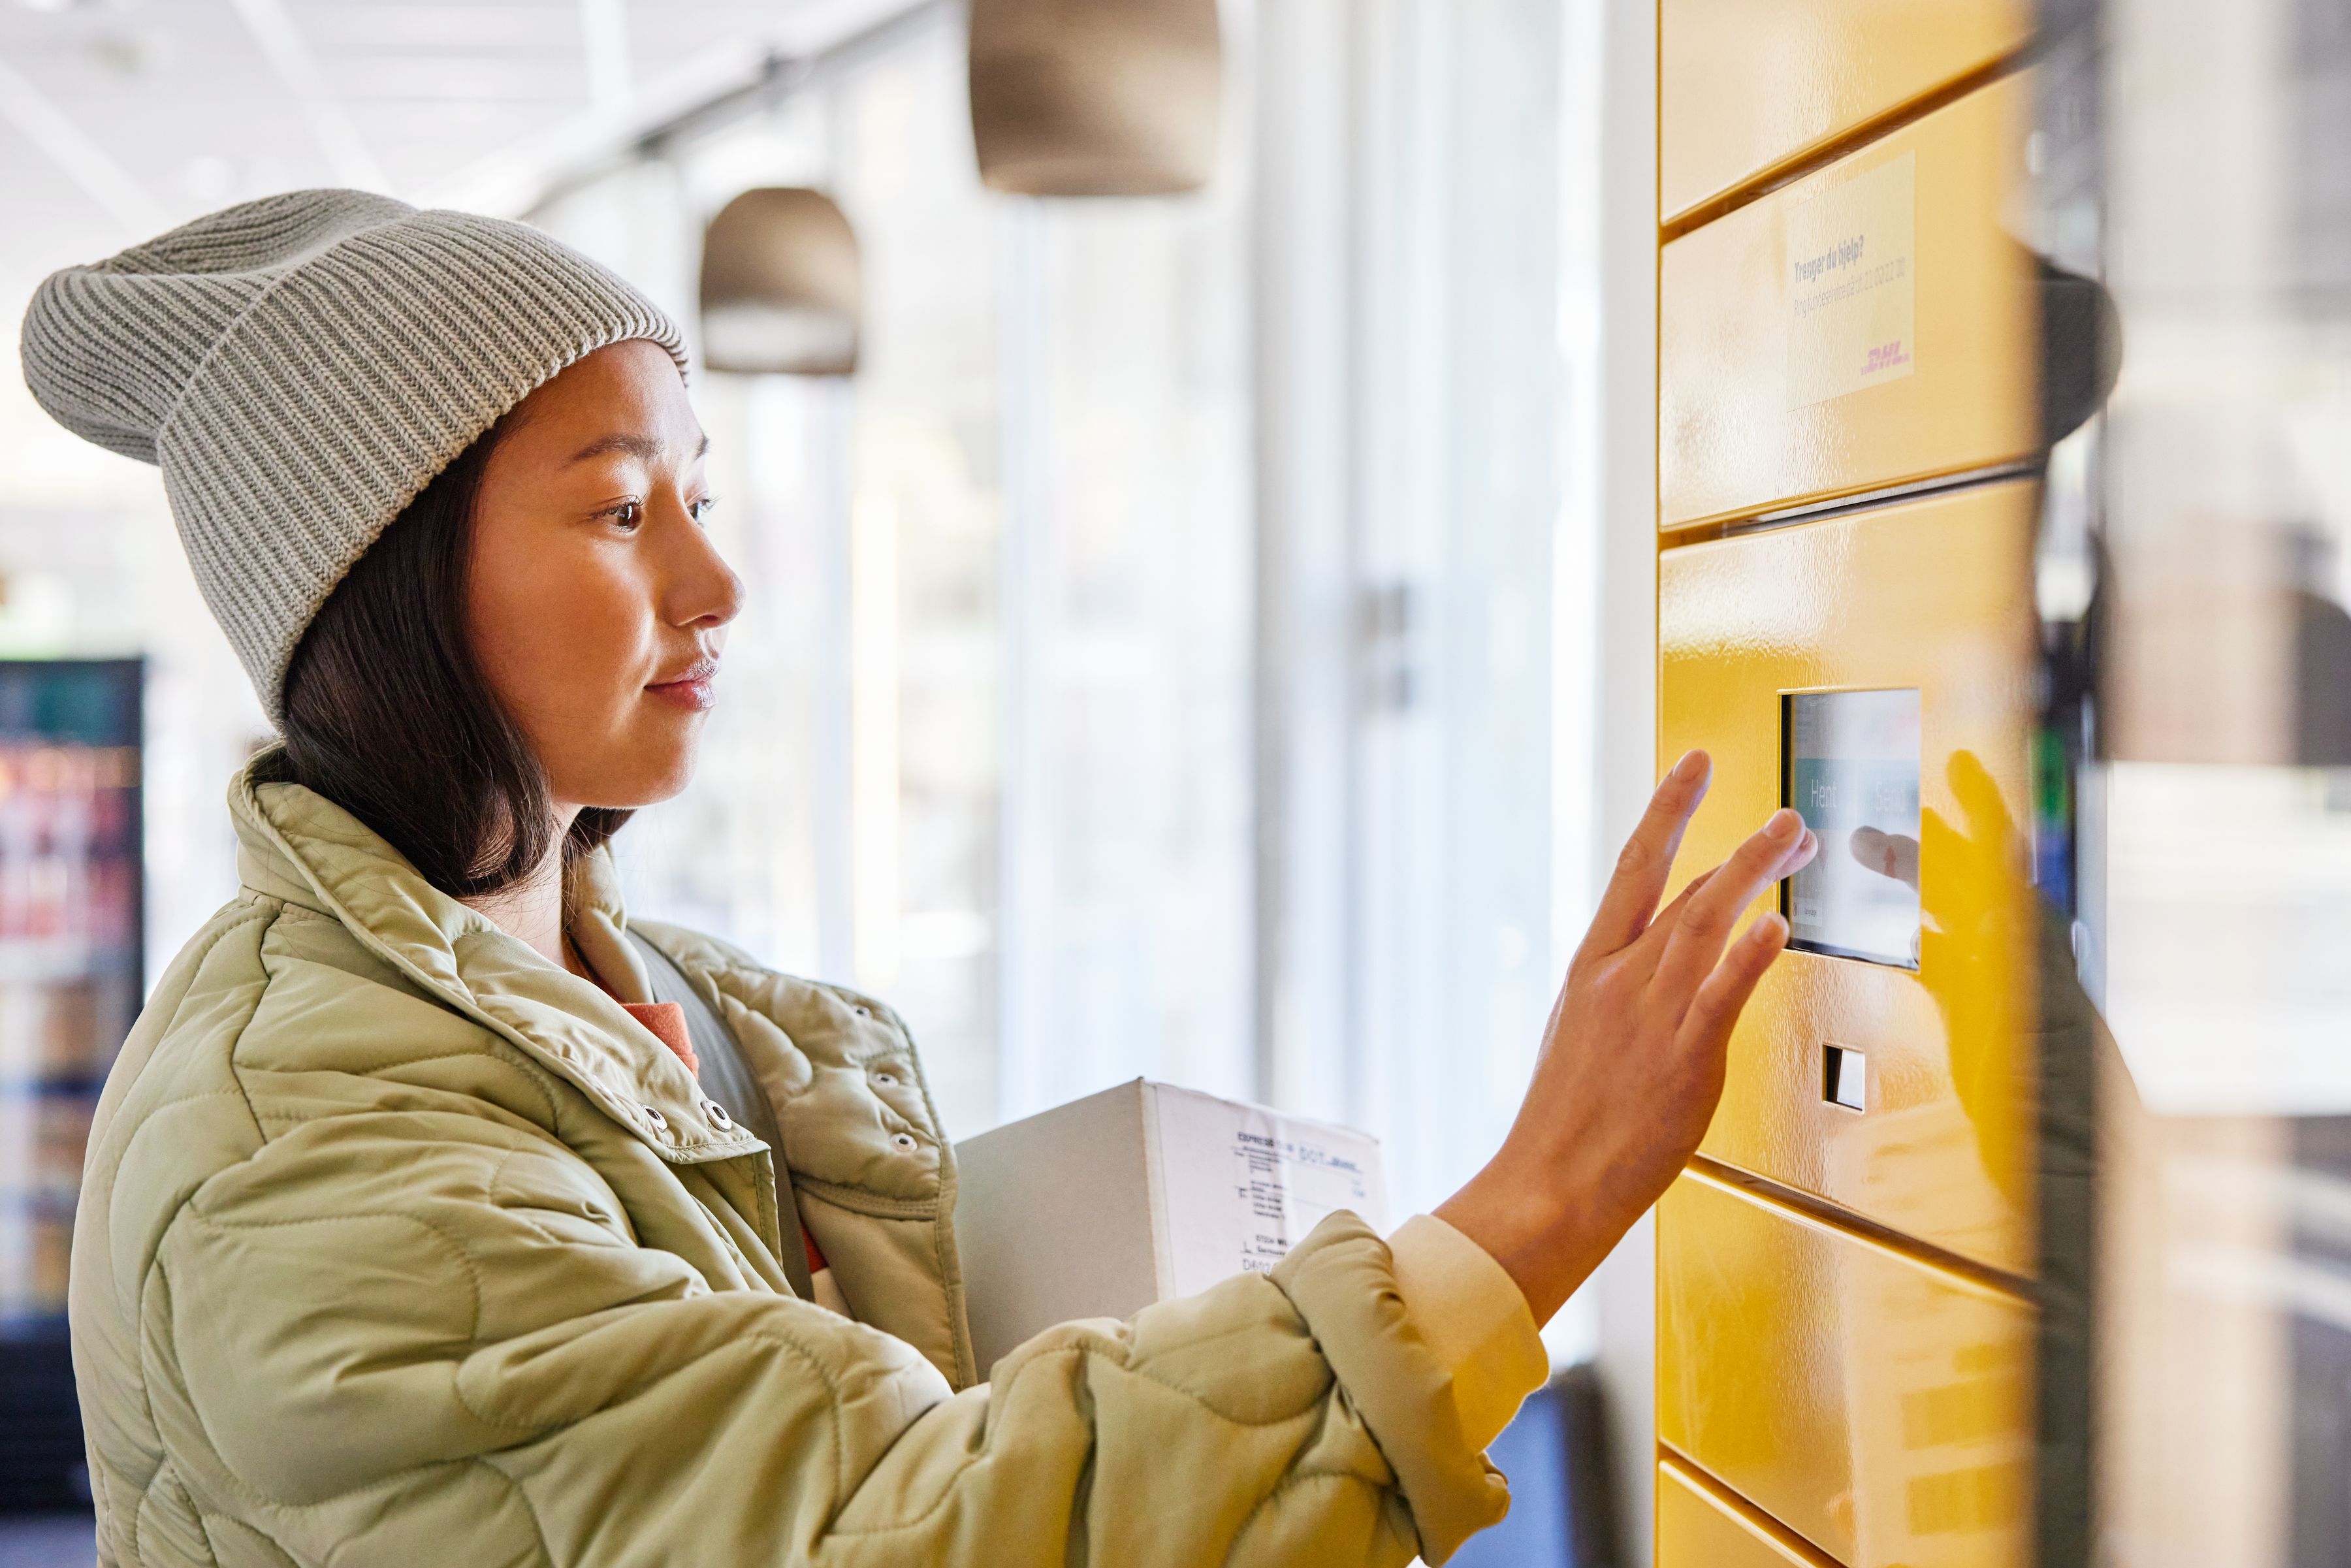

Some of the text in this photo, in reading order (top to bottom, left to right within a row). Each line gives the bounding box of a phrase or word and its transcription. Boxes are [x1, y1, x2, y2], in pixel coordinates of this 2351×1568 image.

[1794, 234, 1864, 283] Trenger du hjelp?
[1793, 298, 1807, 319] Ring
[1864, 340, 1906, 374] DHL
[1810, 778, 1837, 808] Hent
